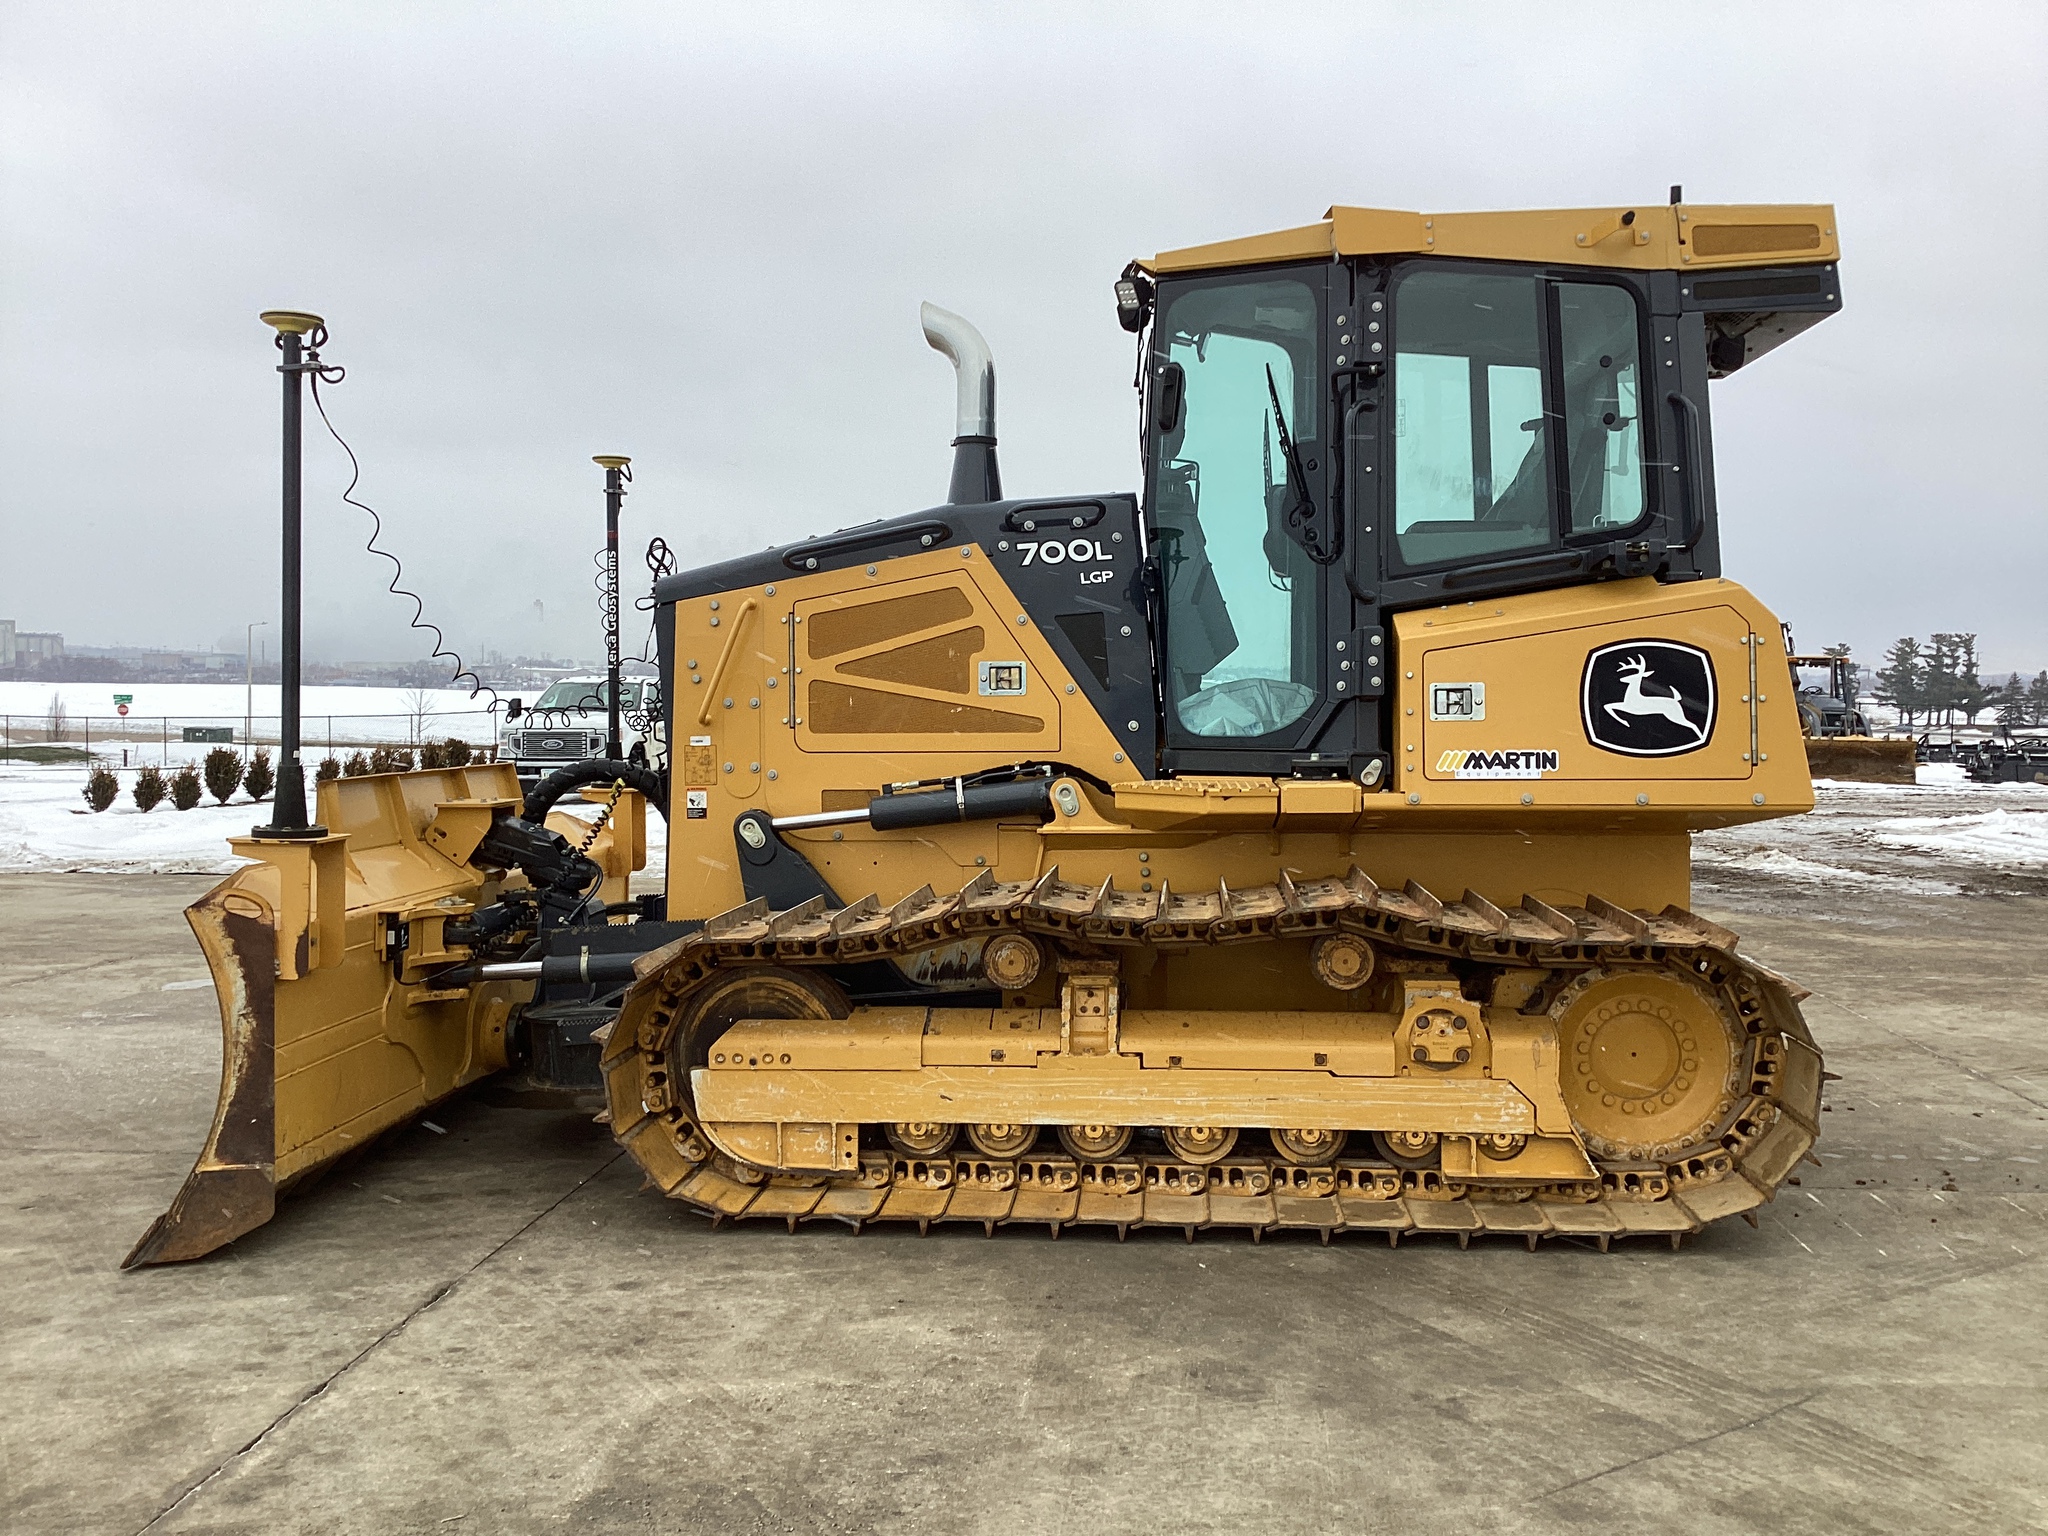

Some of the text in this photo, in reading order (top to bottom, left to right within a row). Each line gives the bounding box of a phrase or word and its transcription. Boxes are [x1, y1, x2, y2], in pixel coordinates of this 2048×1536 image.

[1016, 538, 1113, 566] 700L
[1080, 570, 1114, 585] LGP
[608, 550, 618, 631] Geosystems
[1463, 752, 1557, 769] MARTIN
